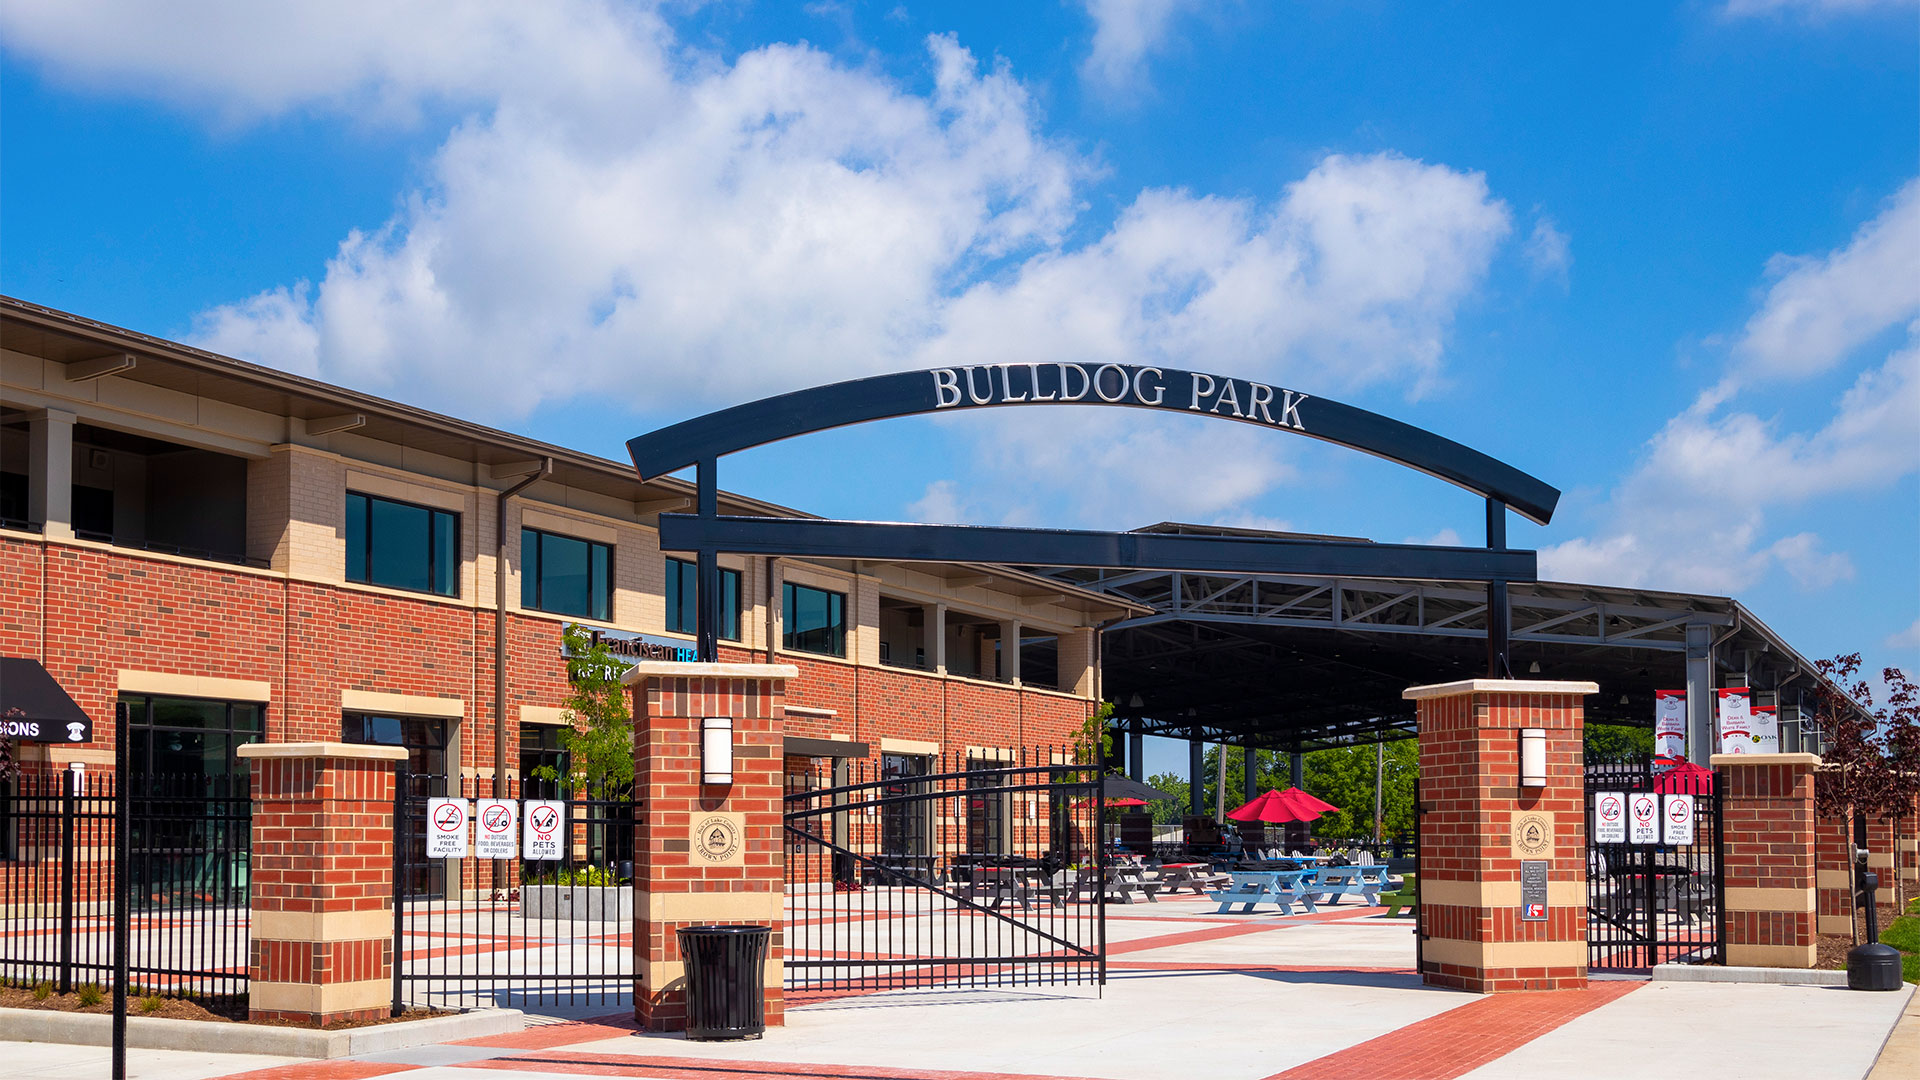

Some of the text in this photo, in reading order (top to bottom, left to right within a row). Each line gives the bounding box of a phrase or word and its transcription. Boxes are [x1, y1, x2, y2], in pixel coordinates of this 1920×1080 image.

[930, 363, 1310, 431] BULLDOG PARK
[597, 631, 674, 661] Franciscan
[697, 844, 737, 860] CROWN POINT
